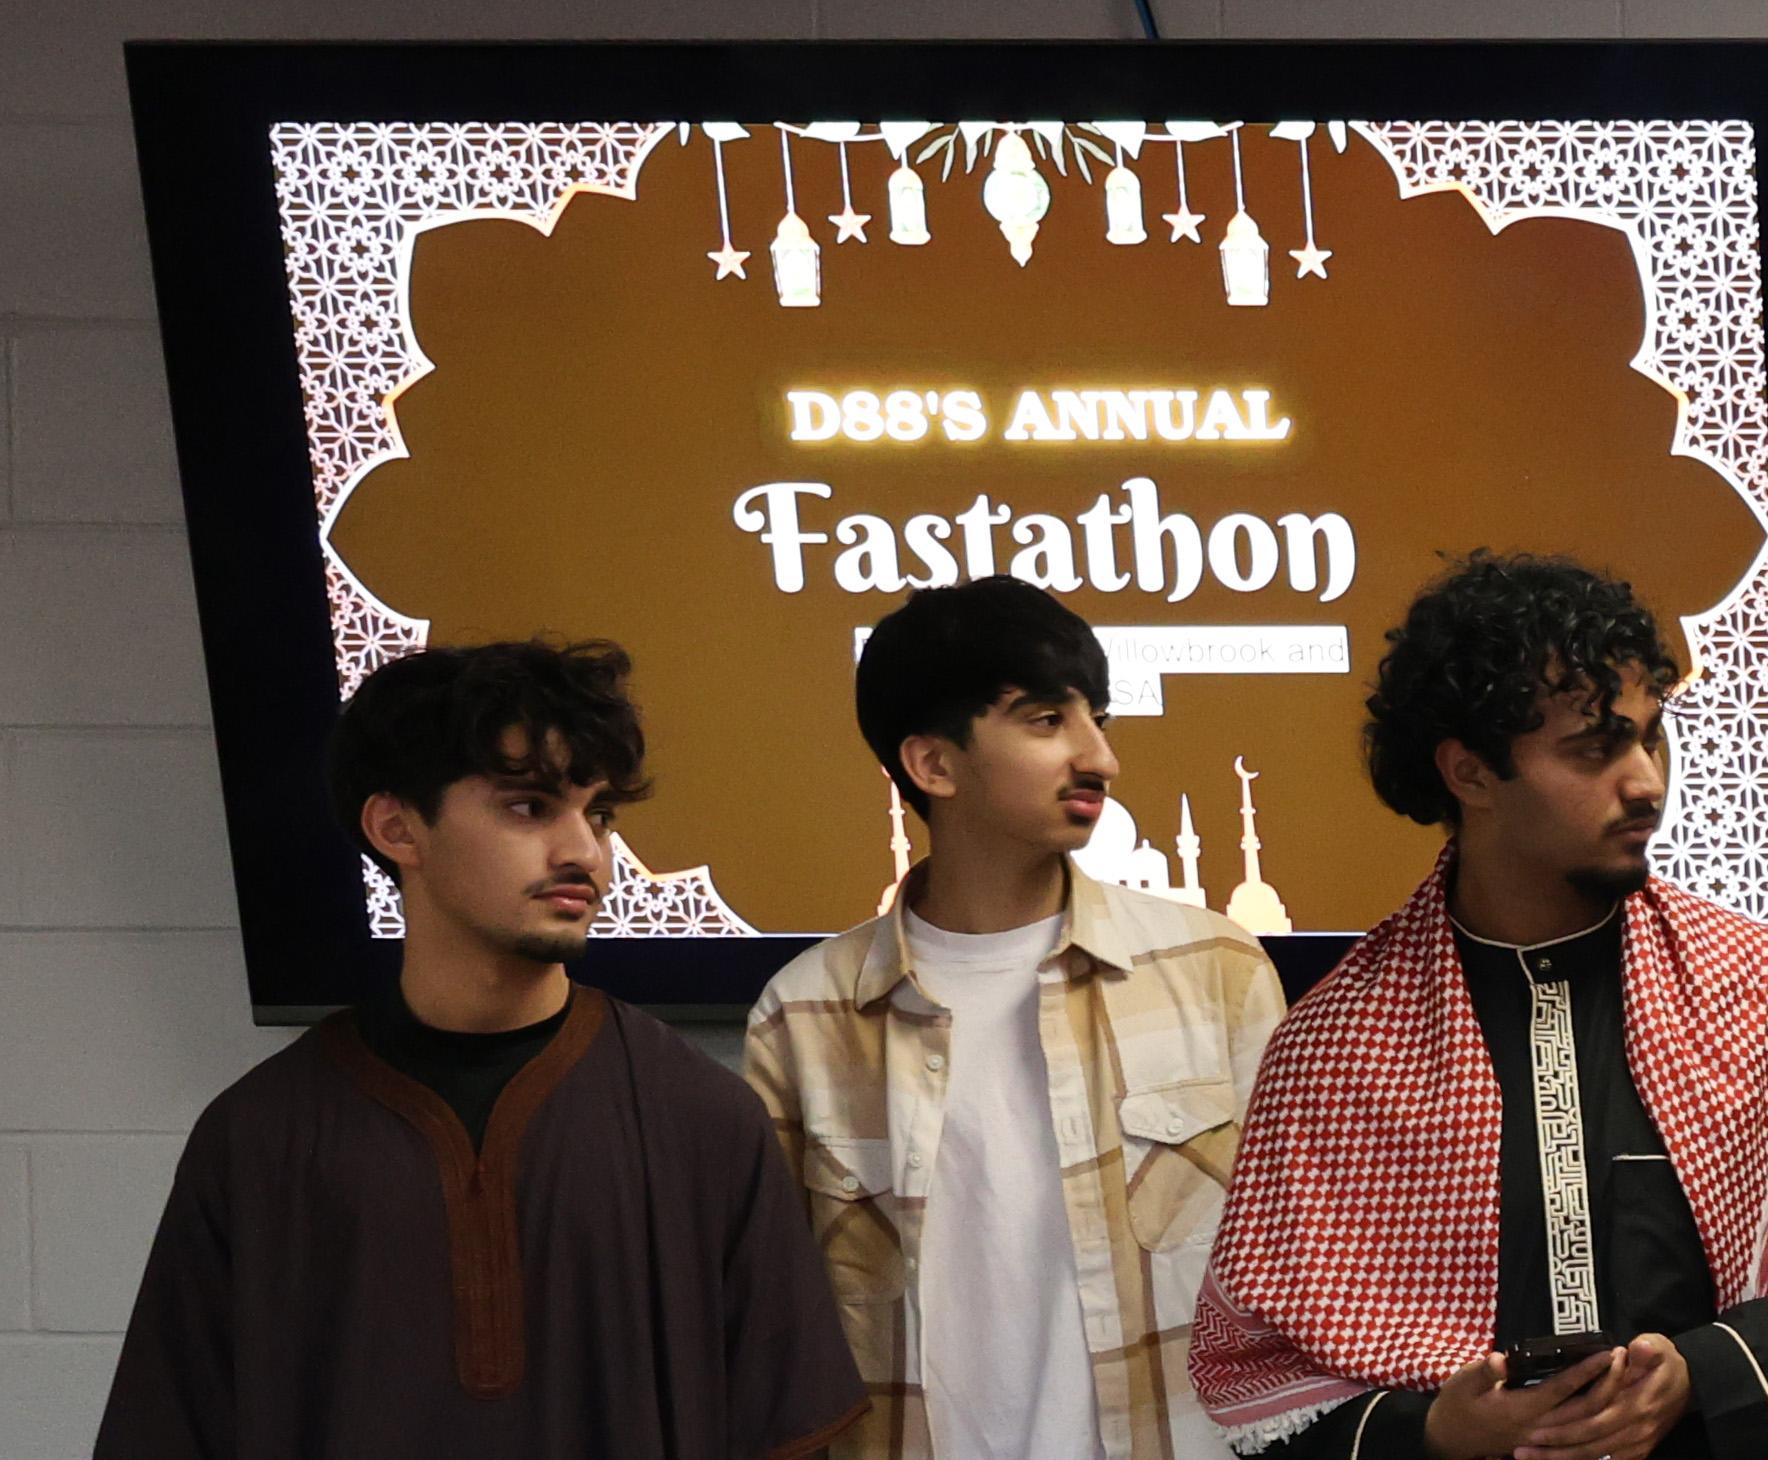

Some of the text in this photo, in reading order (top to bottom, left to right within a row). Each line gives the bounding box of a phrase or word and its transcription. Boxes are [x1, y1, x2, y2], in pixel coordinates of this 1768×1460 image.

[788, 390, 1291, 441] D88'S ANNUAL
[733, 477, 1357, 604] Fastathon
[1104, 636, 1344, 665] illowbrook and
